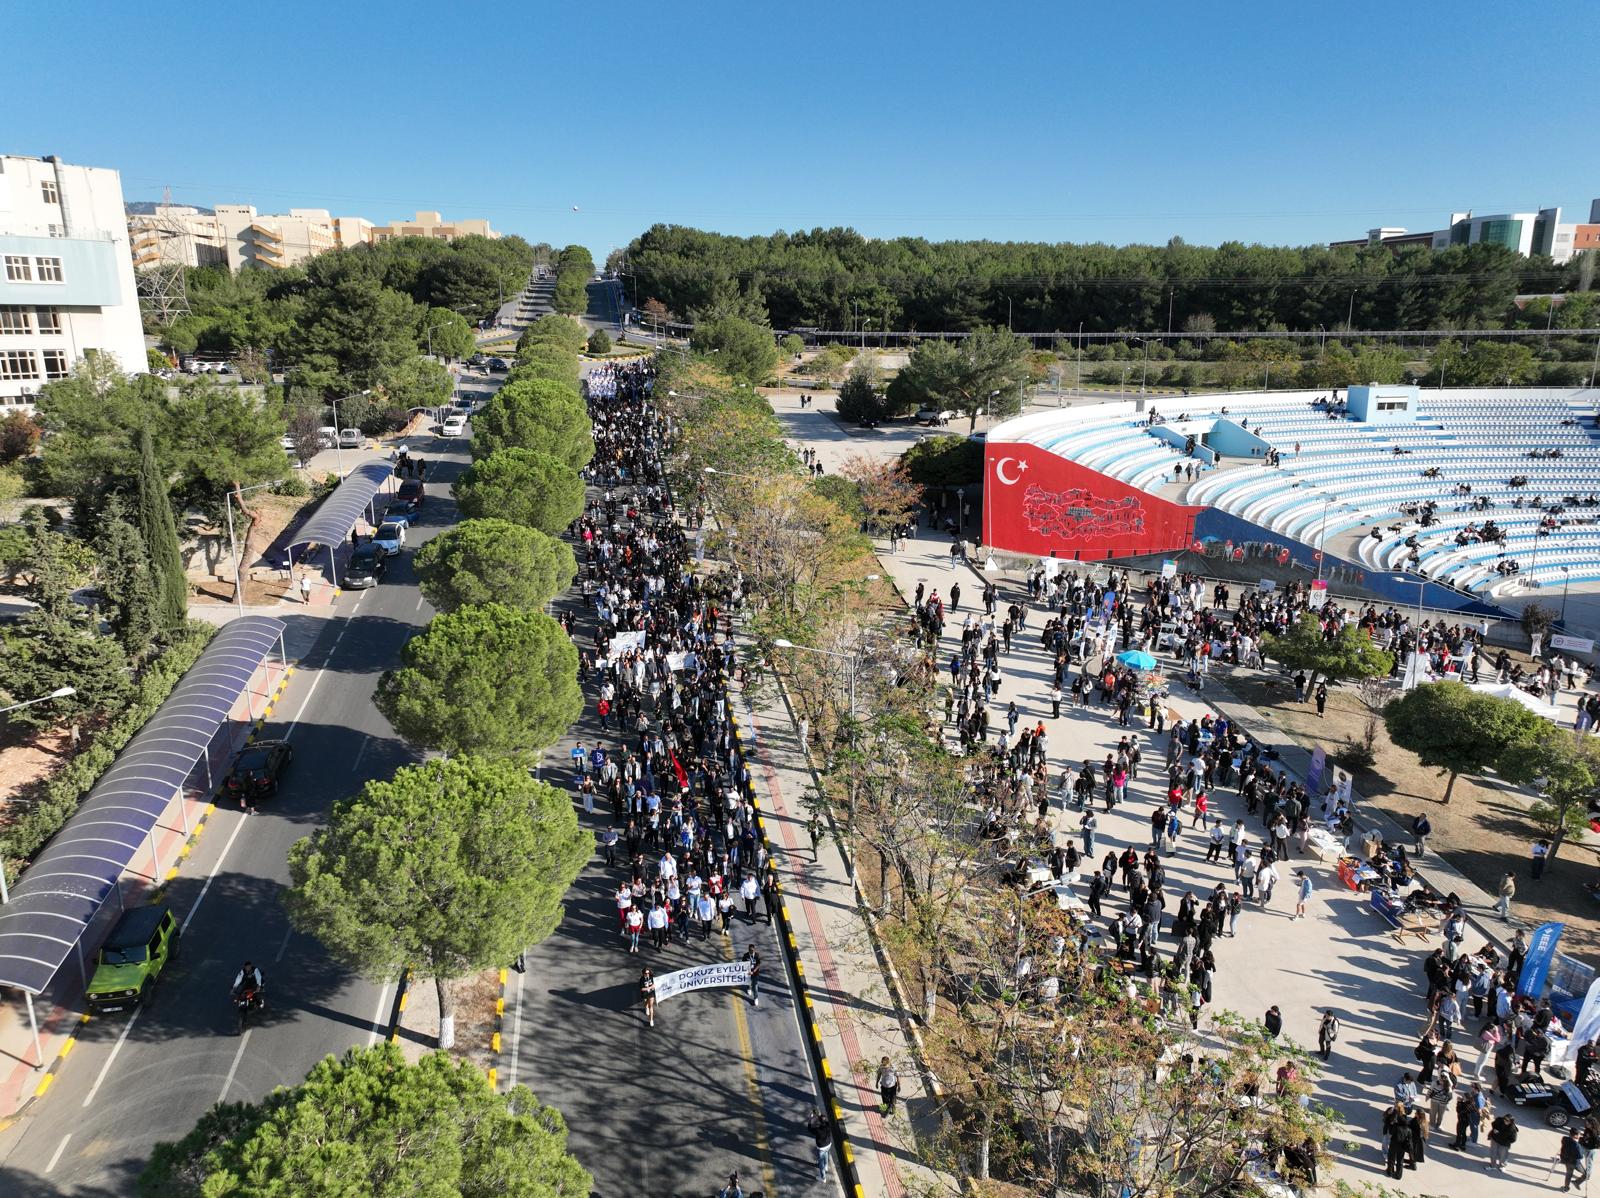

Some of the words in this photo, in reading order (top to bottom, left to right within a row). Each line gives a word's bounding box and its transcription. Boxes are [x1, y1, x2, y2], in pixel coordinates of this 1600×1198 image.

[1537, 933, 1551, 952] IEEE
[678, 968, 714, 981] DOKUZ
[716, 964, 747, 974] EYLÜL
[680, 973, 746, 989] ÜNİVERSİTESİ
